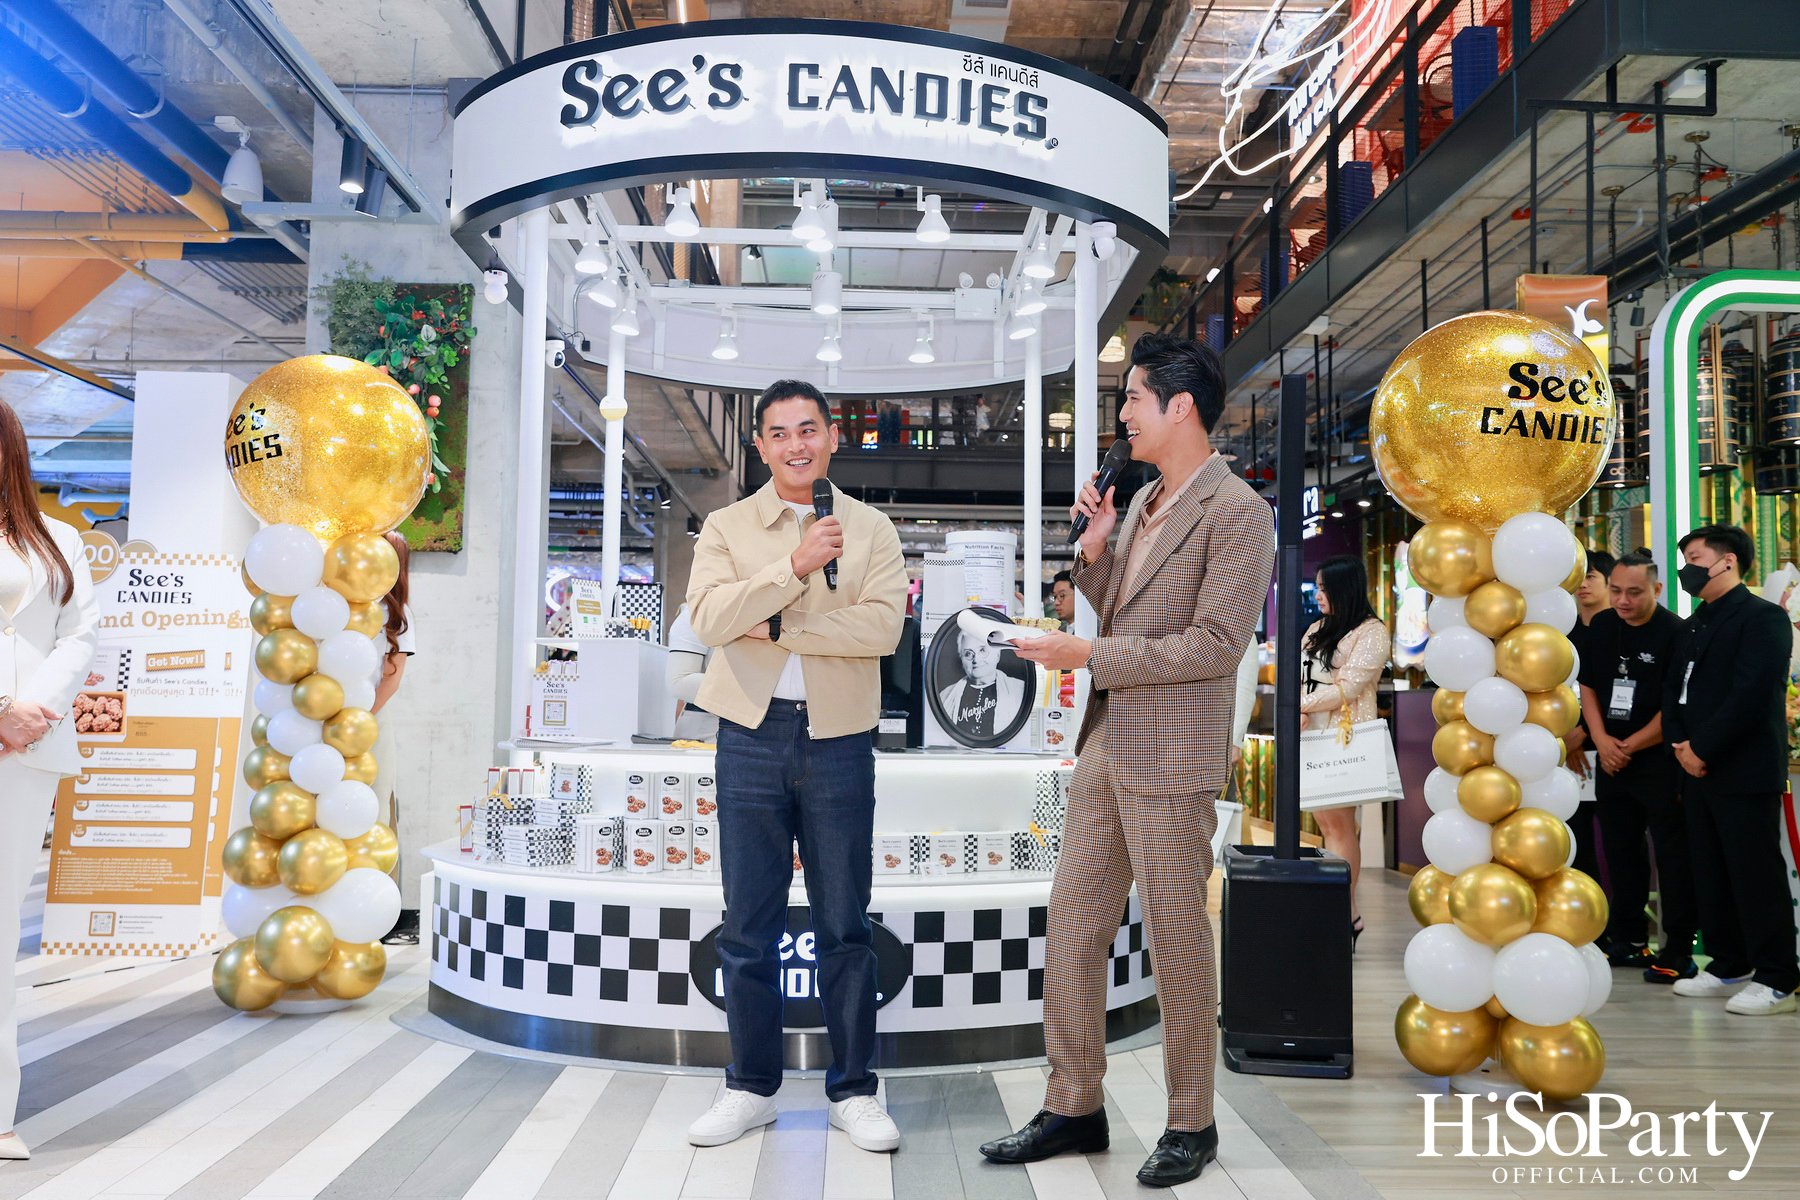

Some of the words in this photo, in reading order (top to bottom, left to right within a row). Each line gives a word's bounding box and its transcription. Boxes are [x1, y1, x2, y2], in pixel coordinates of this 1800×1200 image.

[962, 54, 984, 75] ซีส์
[990, 63, 1039, 89] แคนดีส์
[560, 54, 743, 129] See's
[1508, 362, 1607, 407] See's
[226, 402, 266, 440] ee's
[226, 433, 283, 469] DIES
[1303, 486, 1319, 517] ra
[128, 568, 184, 588] See's
[117, 590, 192, 604] CANDIES
[98, 611, 134, 629] nd
[147, 656, 168, 667] Get
[1306, 761, 1331, 770] See's
